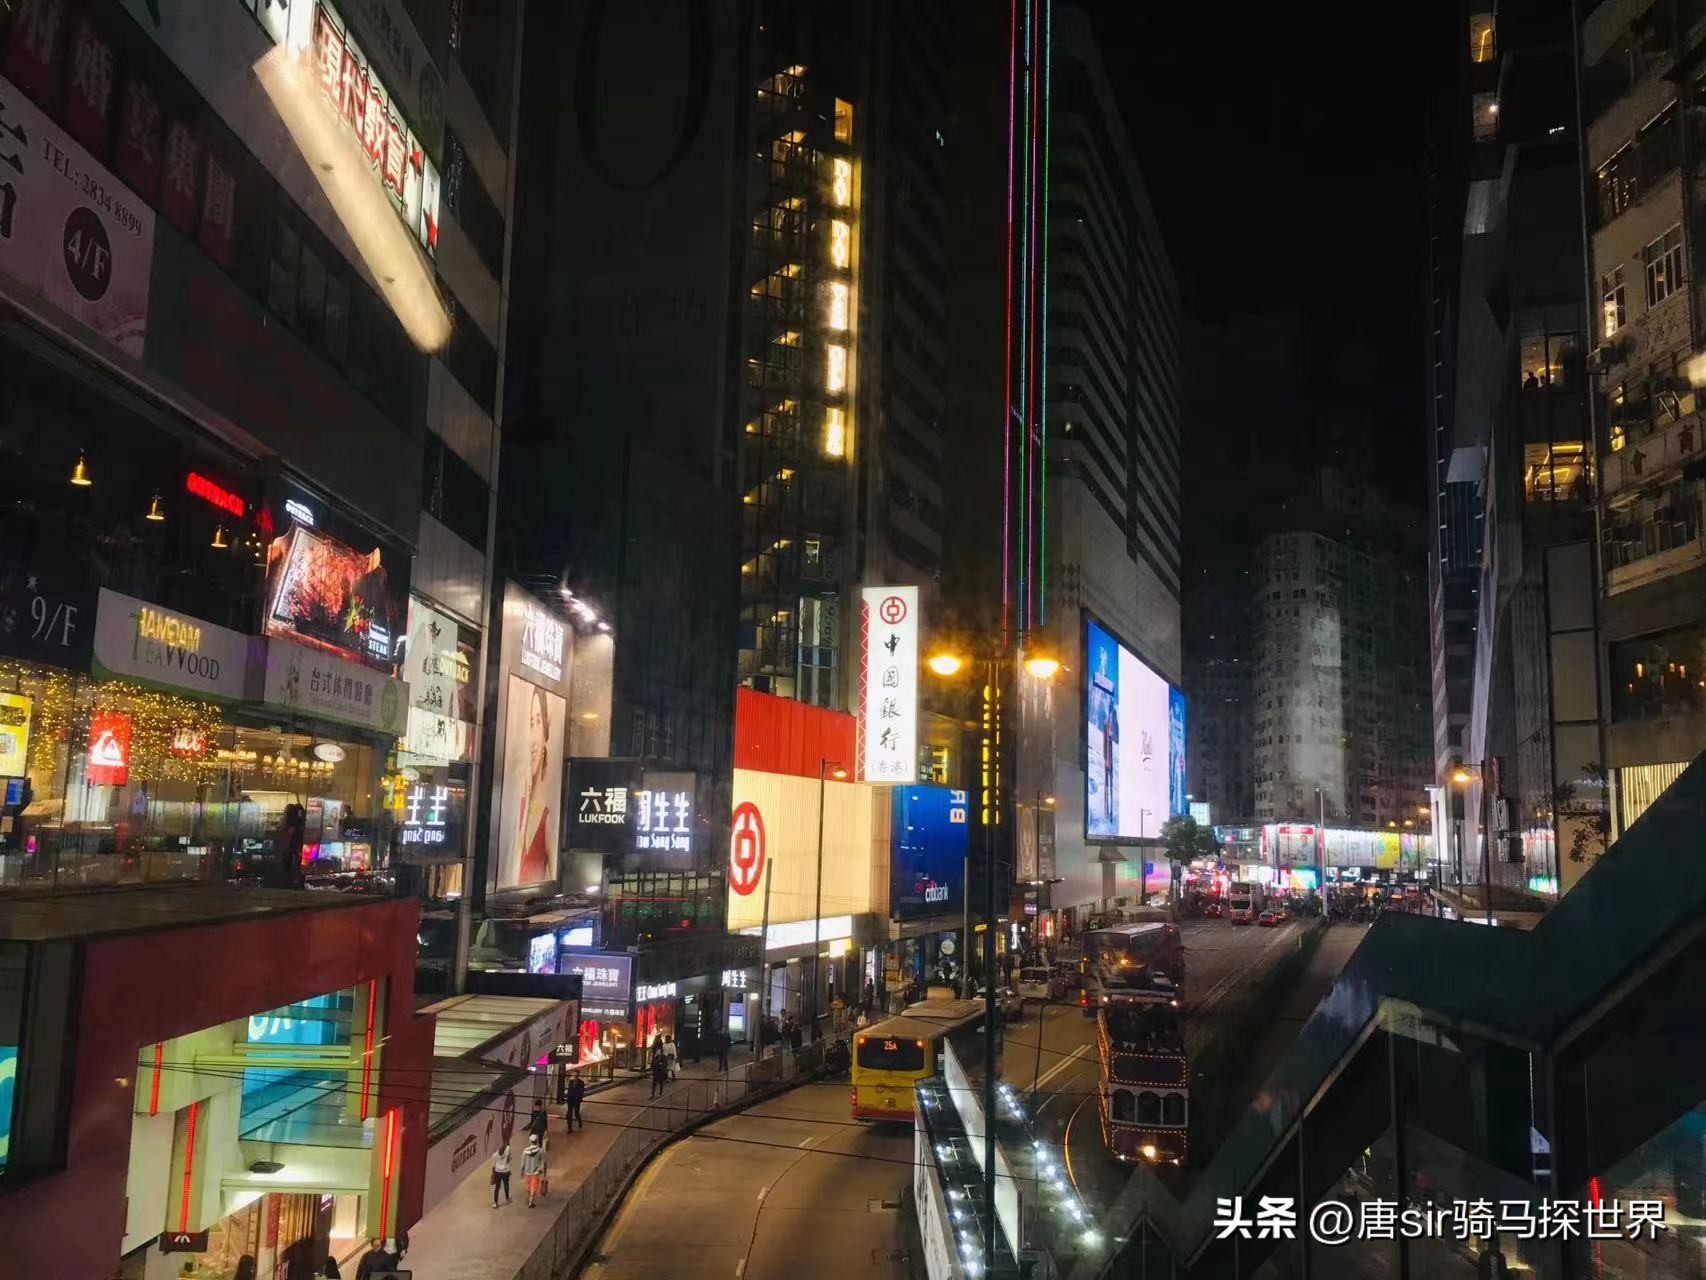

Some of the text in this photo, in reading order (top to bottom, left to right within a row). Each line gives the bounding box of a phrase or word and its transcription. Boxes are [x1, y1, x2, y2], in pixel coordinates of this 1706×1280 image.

[317, 12, 410, 200] 現代教育
[43, 138, 143, 237] TEL: 2834 8899
[68, 229, 108, 280] 4/F
[31, 595, 77, 647] 9/F
[580, 786, 628, 814] 六福
[578, 813, 627, 825] LUKFOOK
[720, 969, 748, 989] 周生生
[556, 1043, 573, 1053] 六福
[884, 1040, 897, 1051] 25A
